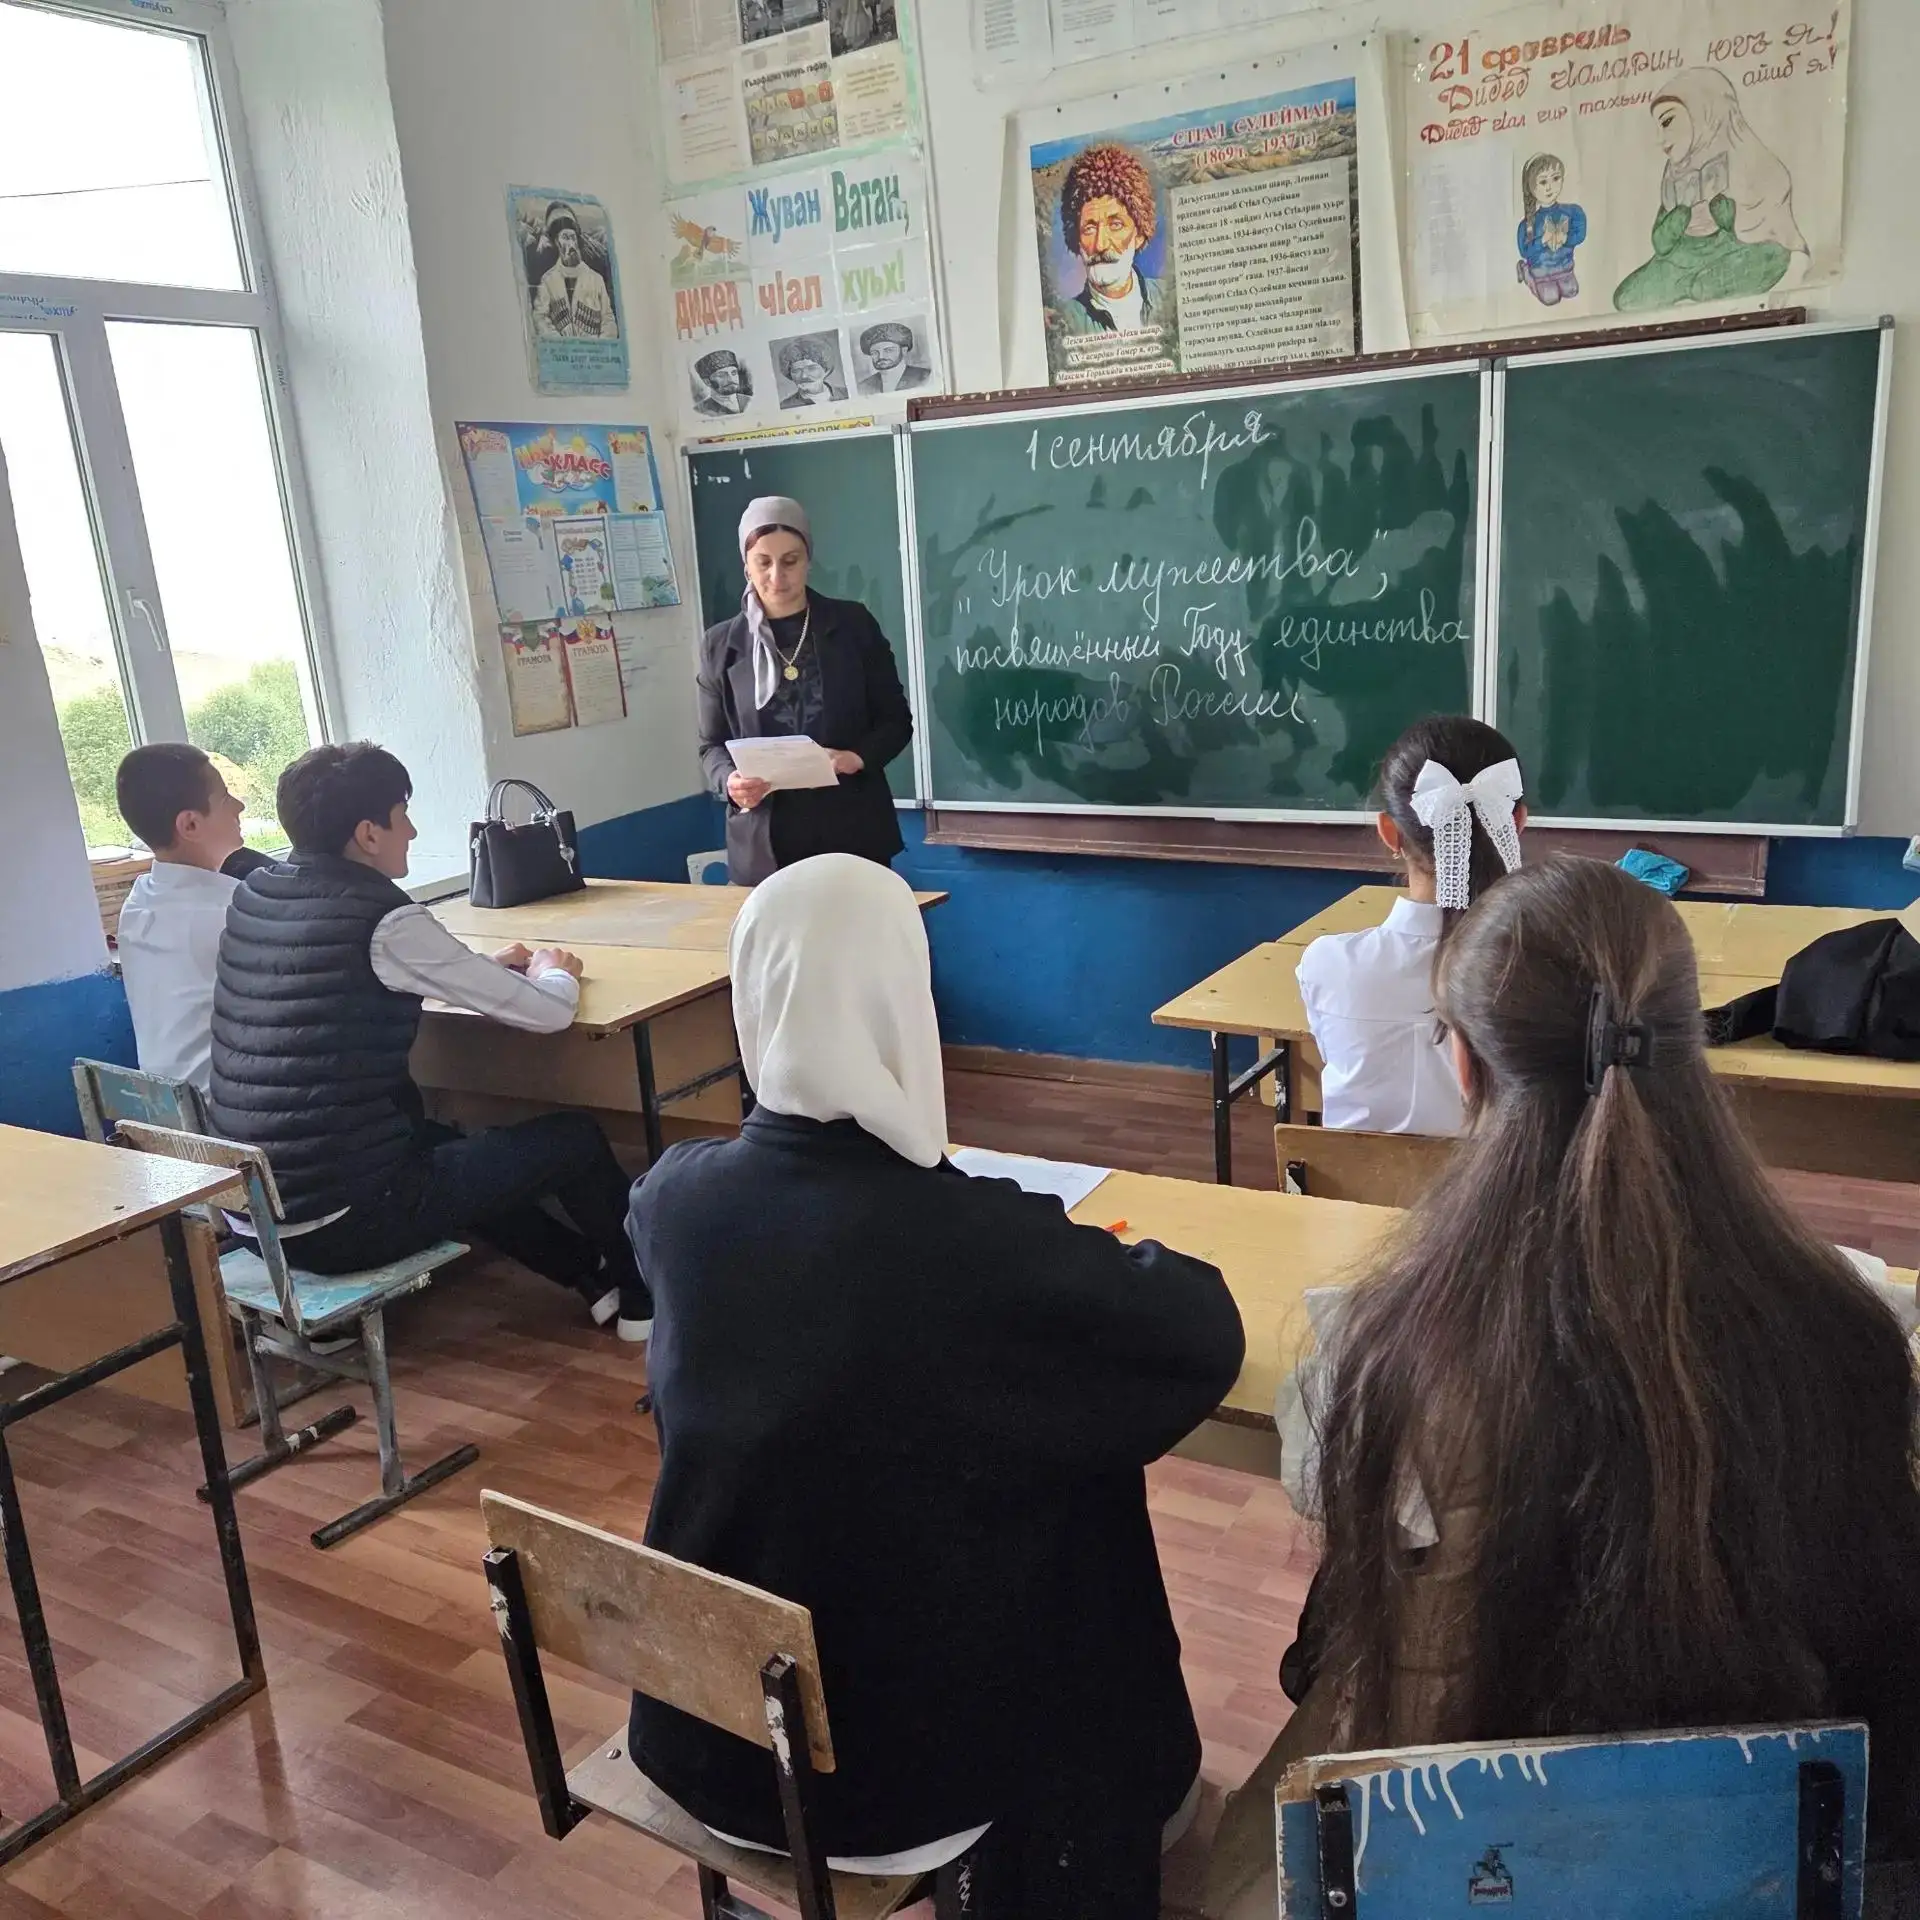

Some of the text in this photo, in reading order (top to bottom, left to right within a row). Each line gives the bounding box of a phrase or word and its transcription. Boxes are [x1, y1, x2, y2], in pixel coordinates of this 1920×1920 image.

[1429, 39, 1471, 82] 21
[1232, 99, 1337, 135] СУЛЕЙМАН
[1194, 146, 1235, 169] (1869
[1262, 132, 1296, 153] 1937
[748, 187, 821, 243] Жуван
[1049, 409, 1272, 489] сентября
[1272, 588, 1470, 669] единства
